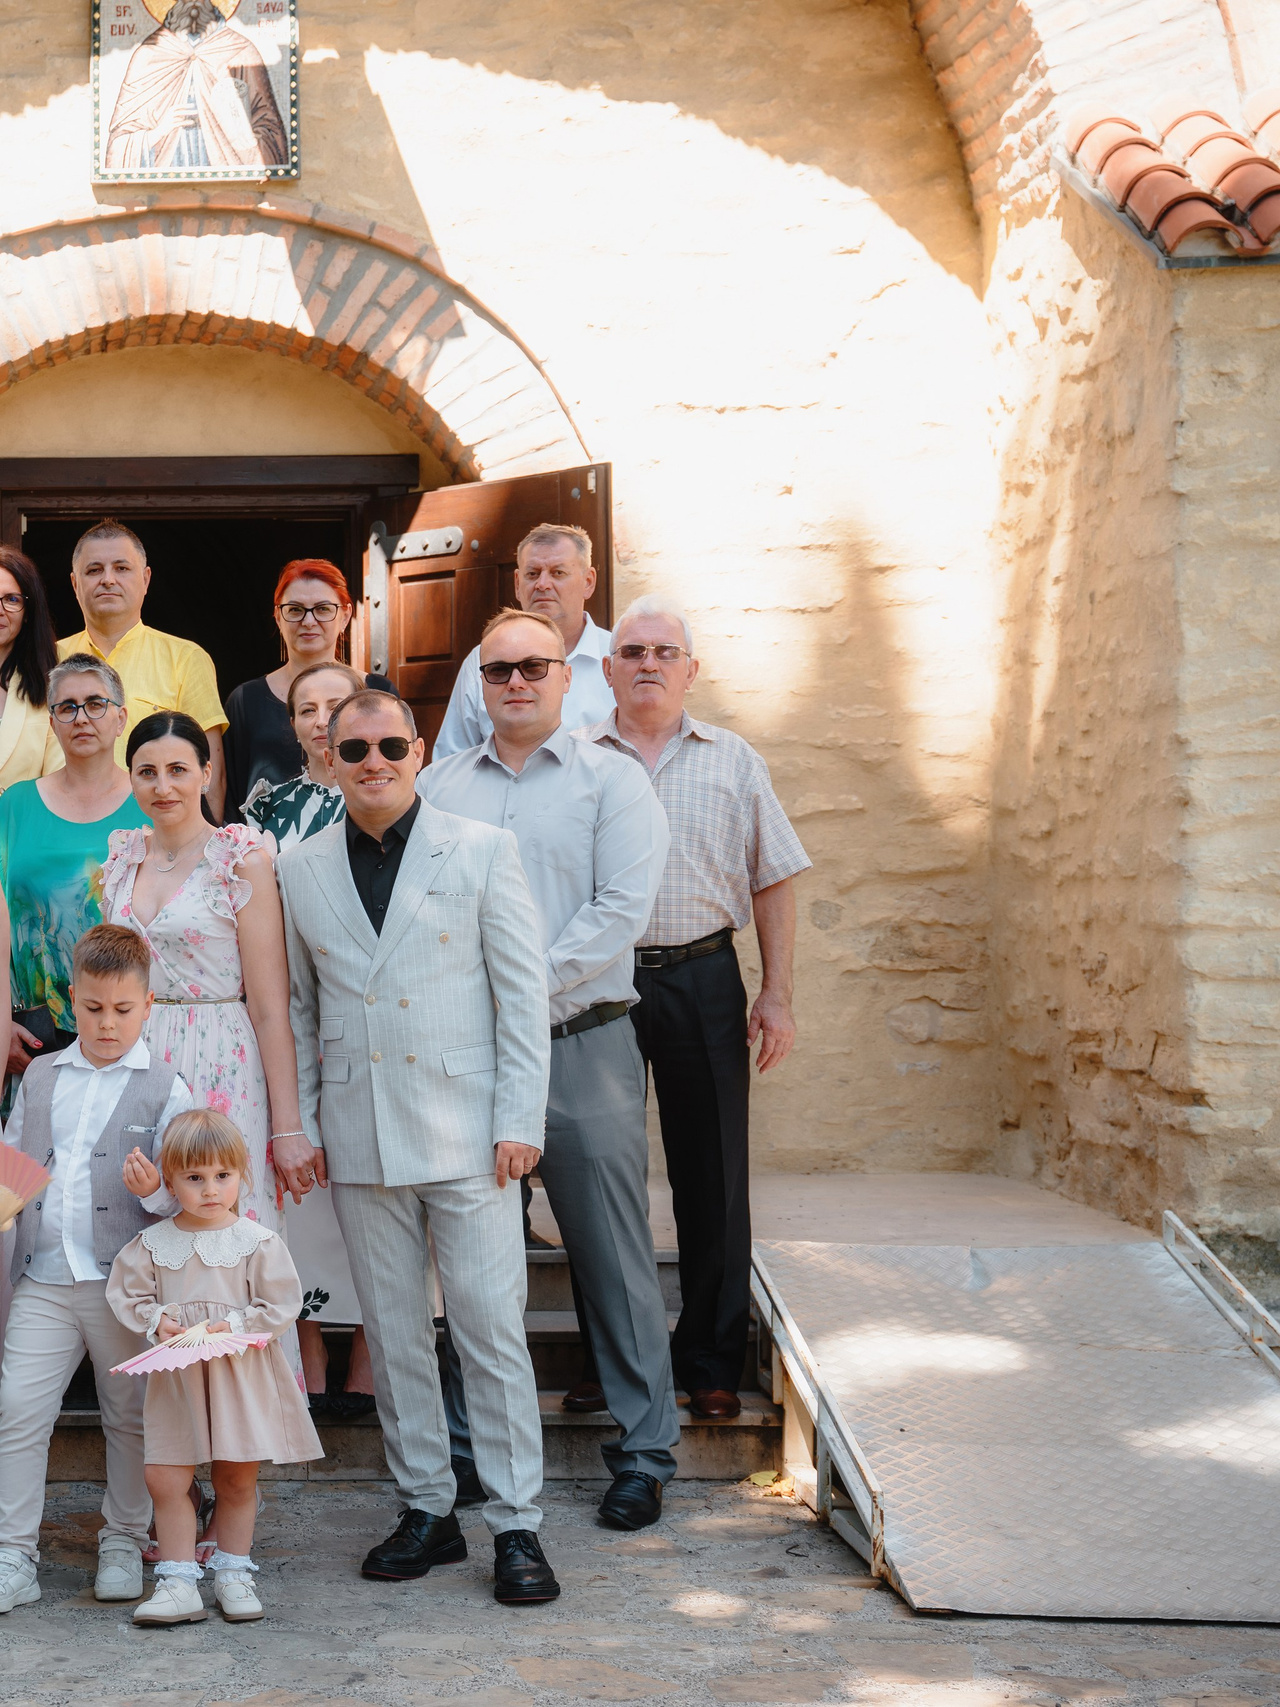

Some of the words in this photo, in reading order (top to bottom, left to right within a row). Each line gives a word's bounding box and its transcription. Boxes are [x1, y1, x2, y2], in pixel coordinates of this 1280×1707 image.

[116, 5, 132, 17] SF.
[256, 2, 283, 14] SAVA
[110, 23, 137, 36] CUV.
